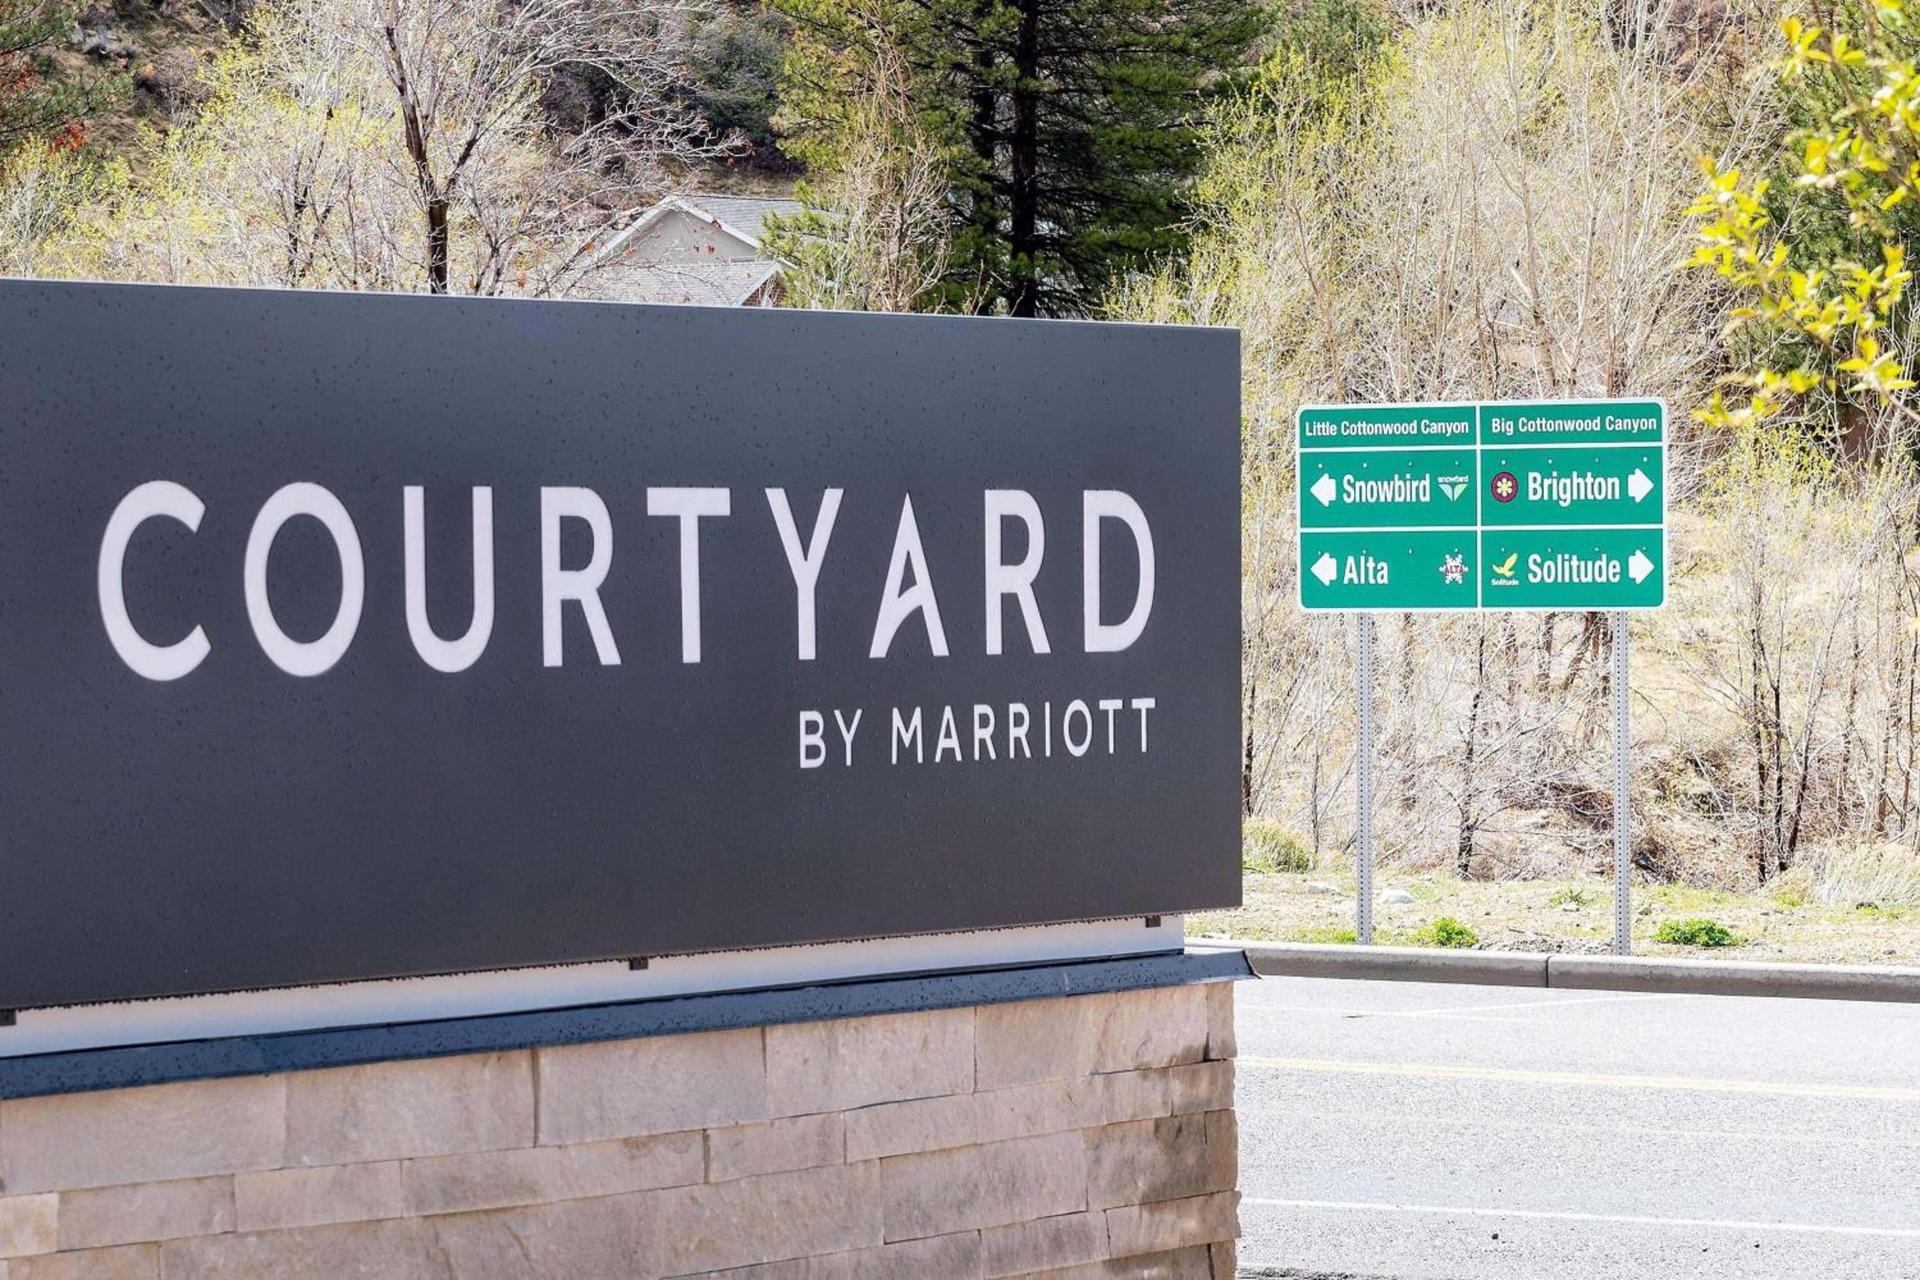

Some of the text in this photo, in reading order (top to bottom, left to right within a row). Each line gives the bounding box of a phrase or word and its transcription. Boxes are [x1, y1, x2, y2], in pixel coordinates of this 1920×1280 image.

[1305, 419, 1469, 437] Little Cottonwood Canyon
[1491, 415, 1657, 436] Big Cottonwood Canyon
[1342, 473, 1431, 503] Snowbird
[1527, 471, 1620, 507] Brighton
[98, 480, 1156, 682] COURTYARD
[1343, 555, 1389, 585] Alta
[1527, 553, 1621, 583] Solitude
[799, 697, 1156, 769] BY MARRIOTT
